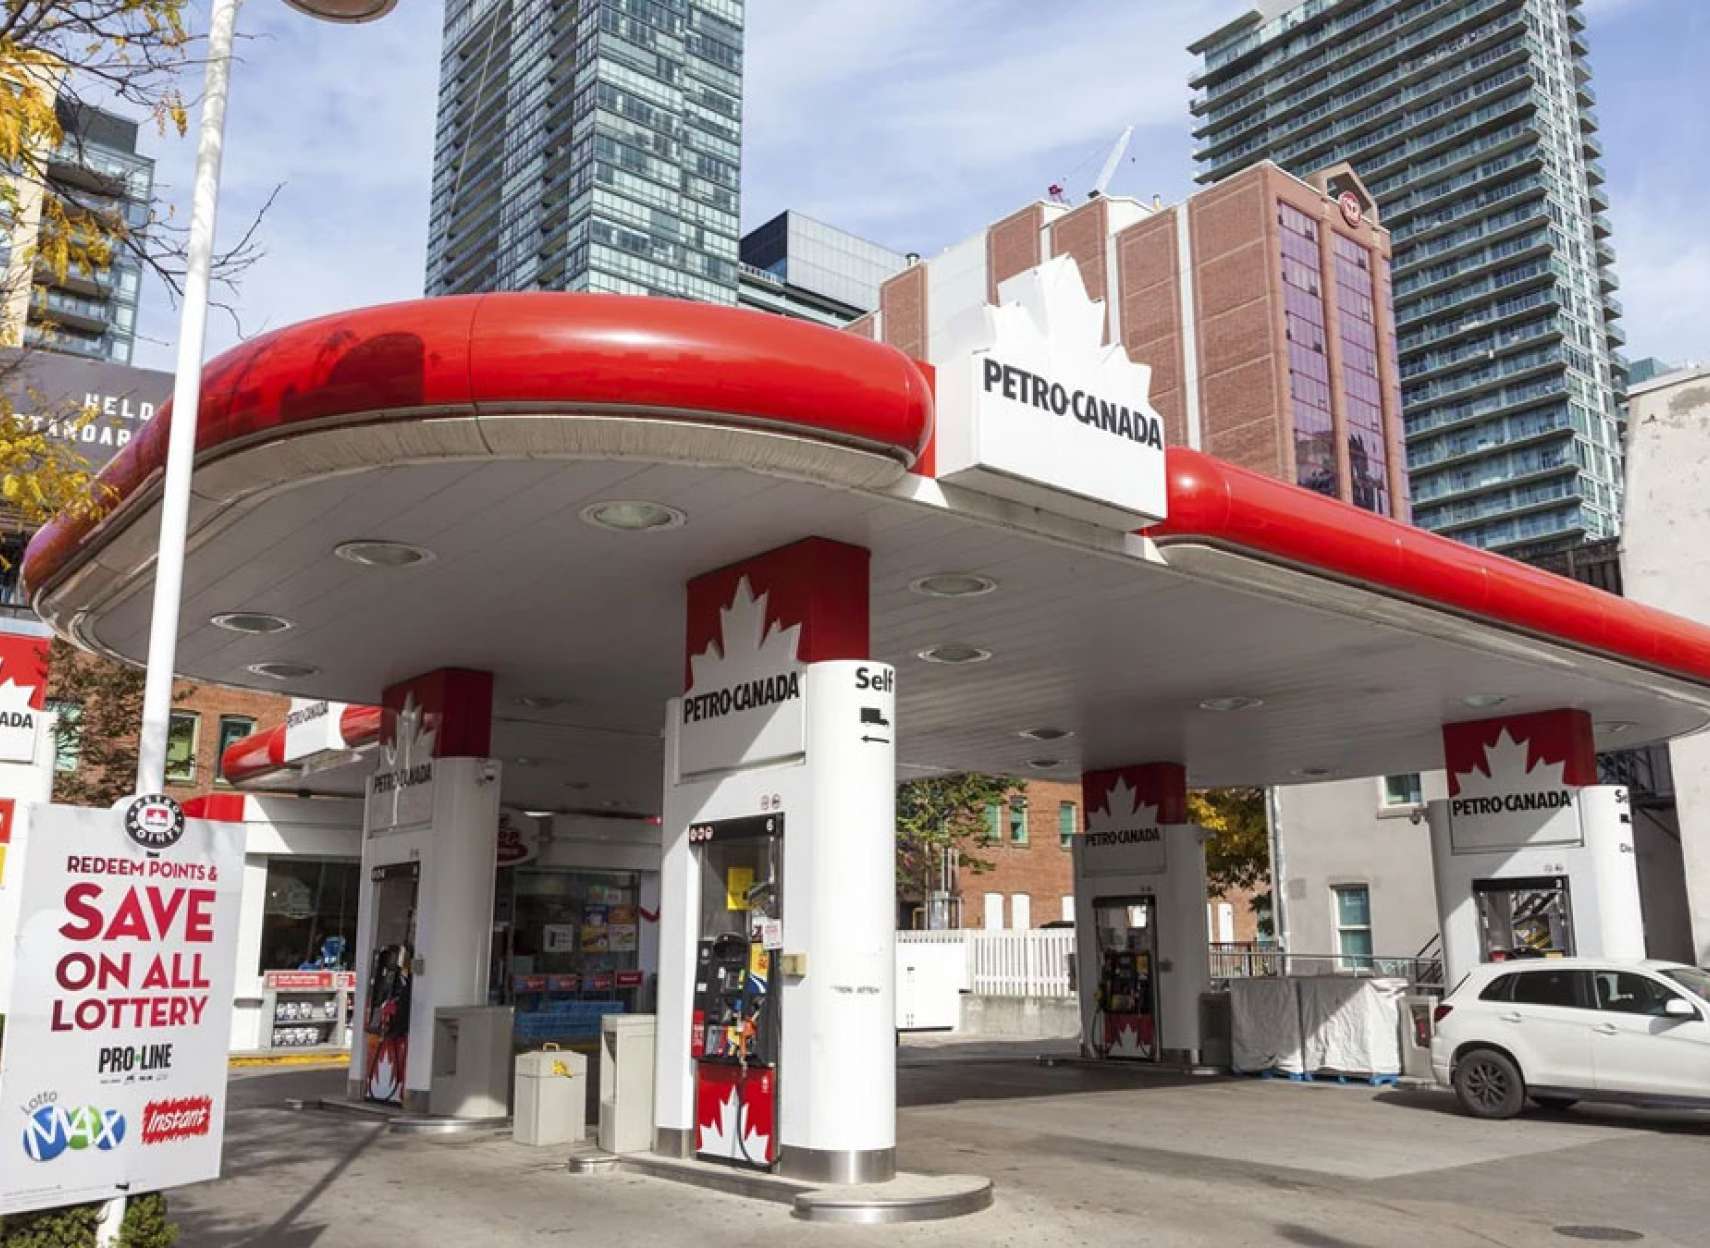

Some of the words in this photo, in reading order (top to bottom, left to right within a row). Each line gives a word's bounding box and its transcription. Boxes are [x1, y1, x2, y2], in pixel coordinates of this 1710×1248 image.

[84, 391, 154, 421] HELD
[855, 666, 894, 694] Self
[67, 855, 145, 876] REDEEM
[149, 858, 206, 881] POINTS
[207, 866, 219, 882] &
[59, 882, 217, 943] SAVE
[55, 951, 131, 993] ON
[142, 951, 211, 990] ALL
[51, 996, 209, 1033] LOTTERY
[20, 1089, 58, 1116] Lotto
[24, 1104, 123, 1161] MAX
[146, 1107, 206, 1134] Instant
